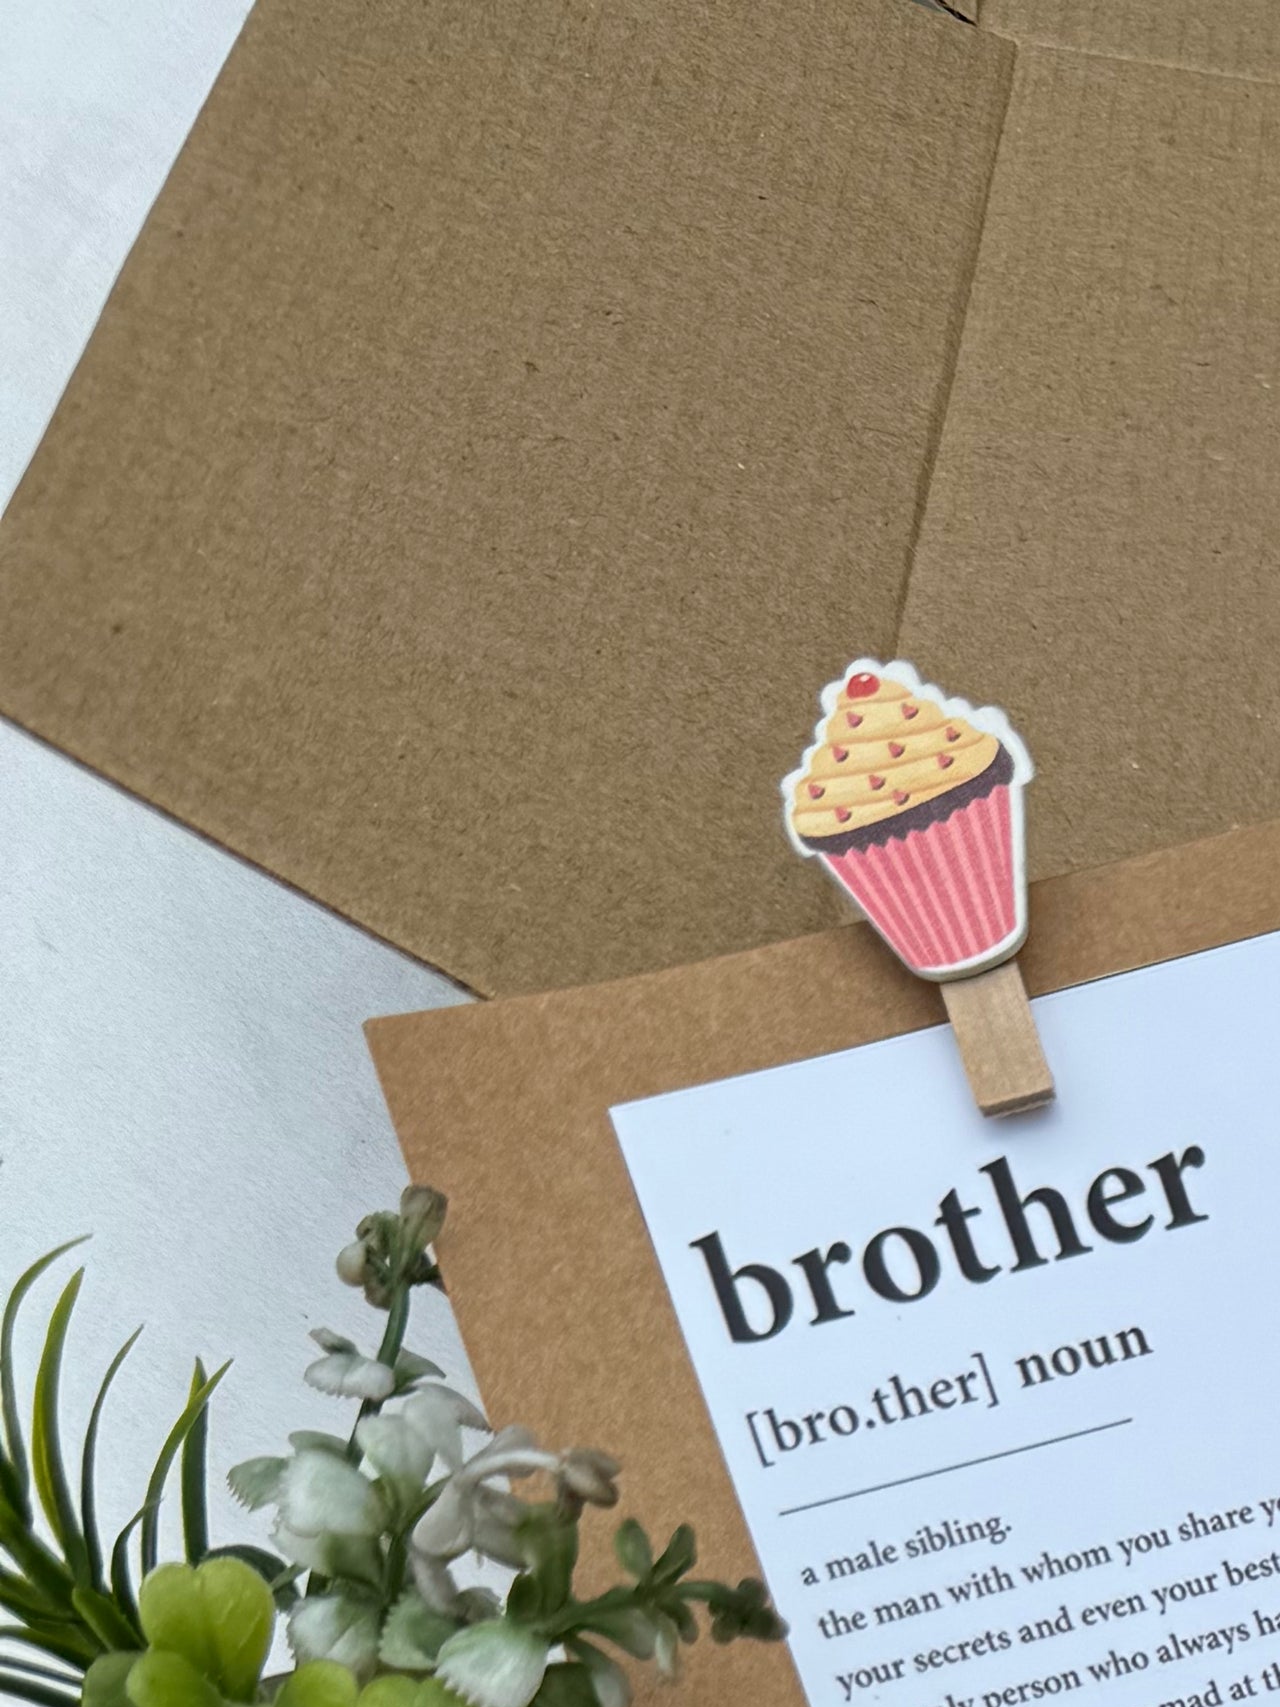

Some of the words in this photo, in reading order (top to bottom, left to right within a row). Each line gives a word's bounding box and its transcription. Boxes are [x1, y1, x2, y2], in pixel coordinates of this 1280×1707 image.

[689, 1145, 1209, 1344] brother
[746, 1352, 999, 1468] [bro.ther]
[1014, 1327, 1153, 1388] noun
[801, 1567, 820, 1586] a
[825, 1540, 899, 1580] male
[904, 1517, 1012, 1559] sibling.
[818, 1609, 868, 1639] the
[873, 1592, 942, 1625] man
[947, 1565, 1015, 1603] with
[1020, 1546, 1112, 1583] whom
[1116, 1529, 1171, 1566] you
[1178, 1506, 1254, 1542] share
[836, 1659, 905, 1702] your
[913, 1631, 1012, 1673] secrets
[1018, 1605, 1075, 1644] and
[1081, 1595, 1147, 1626] even
[1150, 1573, 1218, 1615] your
[1087, 1650, 1150, 1682] who
[1156, 1623, 1251, 1664] always
[1229, 1675, 1258, 1701] at
